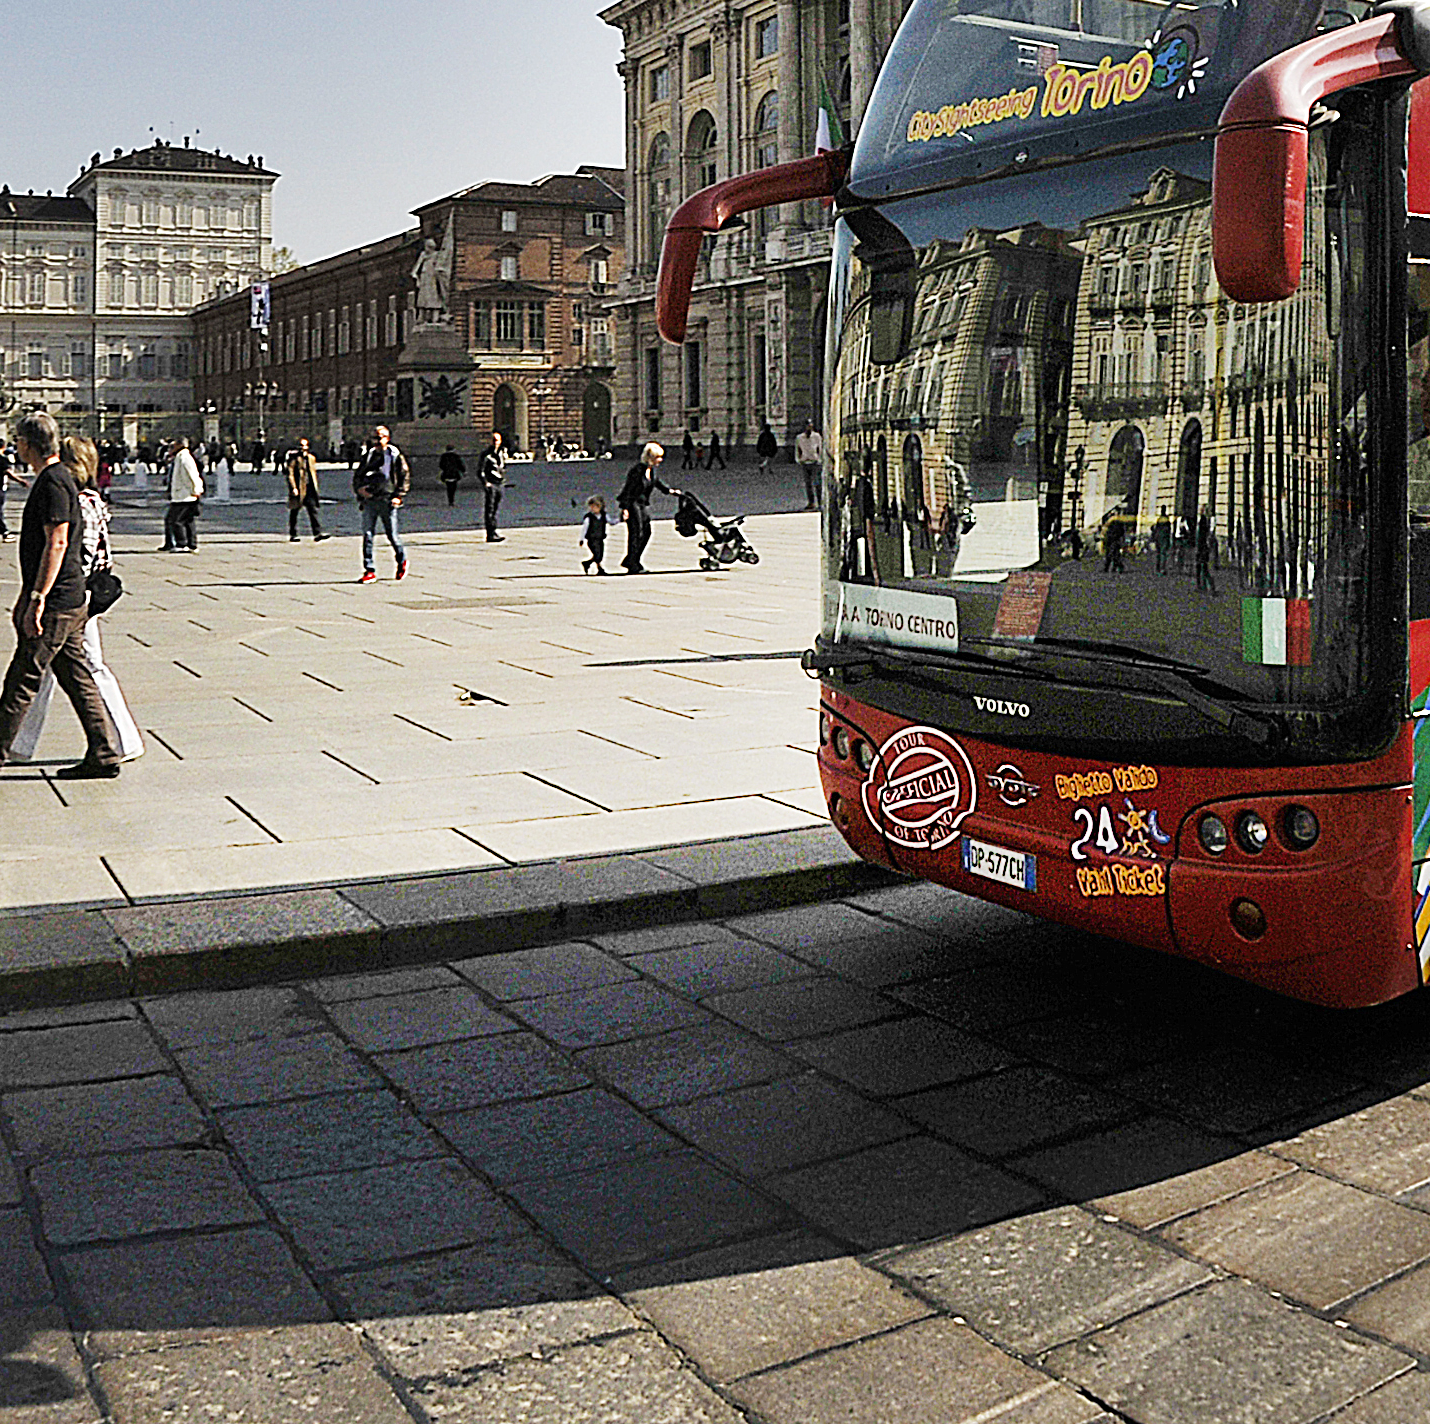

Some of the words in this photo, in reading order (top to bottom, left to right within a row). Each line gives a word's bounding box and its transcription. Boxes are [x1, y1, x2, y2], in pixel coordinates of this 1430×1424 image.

[907, 86, 1039, 142] CitySightseeing
[1041, 50, 1154, 118] Torino
[865, 607, 904, 631] TORNO
[907, 614, 956, 639] CENTRO
[973, 695, 1030, 718] VOLVO
[893, 732, 926, 754] TOUR
[882, 769, 955, 803] OFFICIAL
[1112, 764, 1159, 792] Valido
[894, 825, 910, 840] OF
[1070, 806, 1120, 860] 24
[1111, 863, 1166, 896] Ticket
